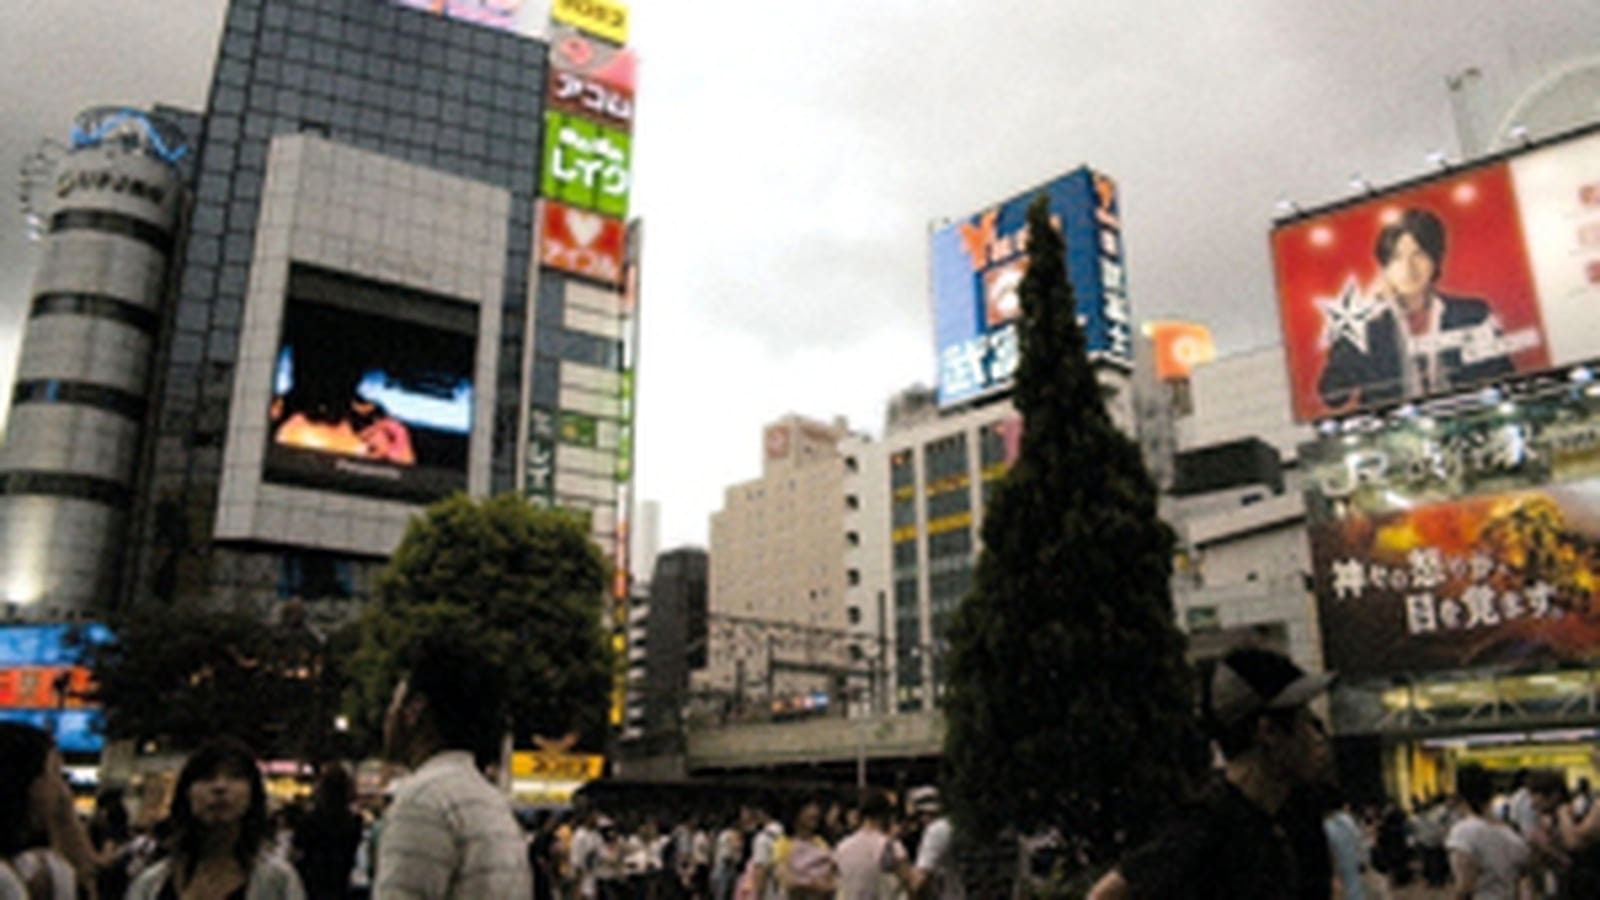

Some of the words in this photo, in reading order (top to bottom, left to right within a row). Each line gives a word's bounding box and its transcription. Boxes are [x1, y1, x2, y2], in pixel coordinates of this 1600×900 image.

[553, 72, 632, 119] アコム
[552, 147, 630, 194] レイク
